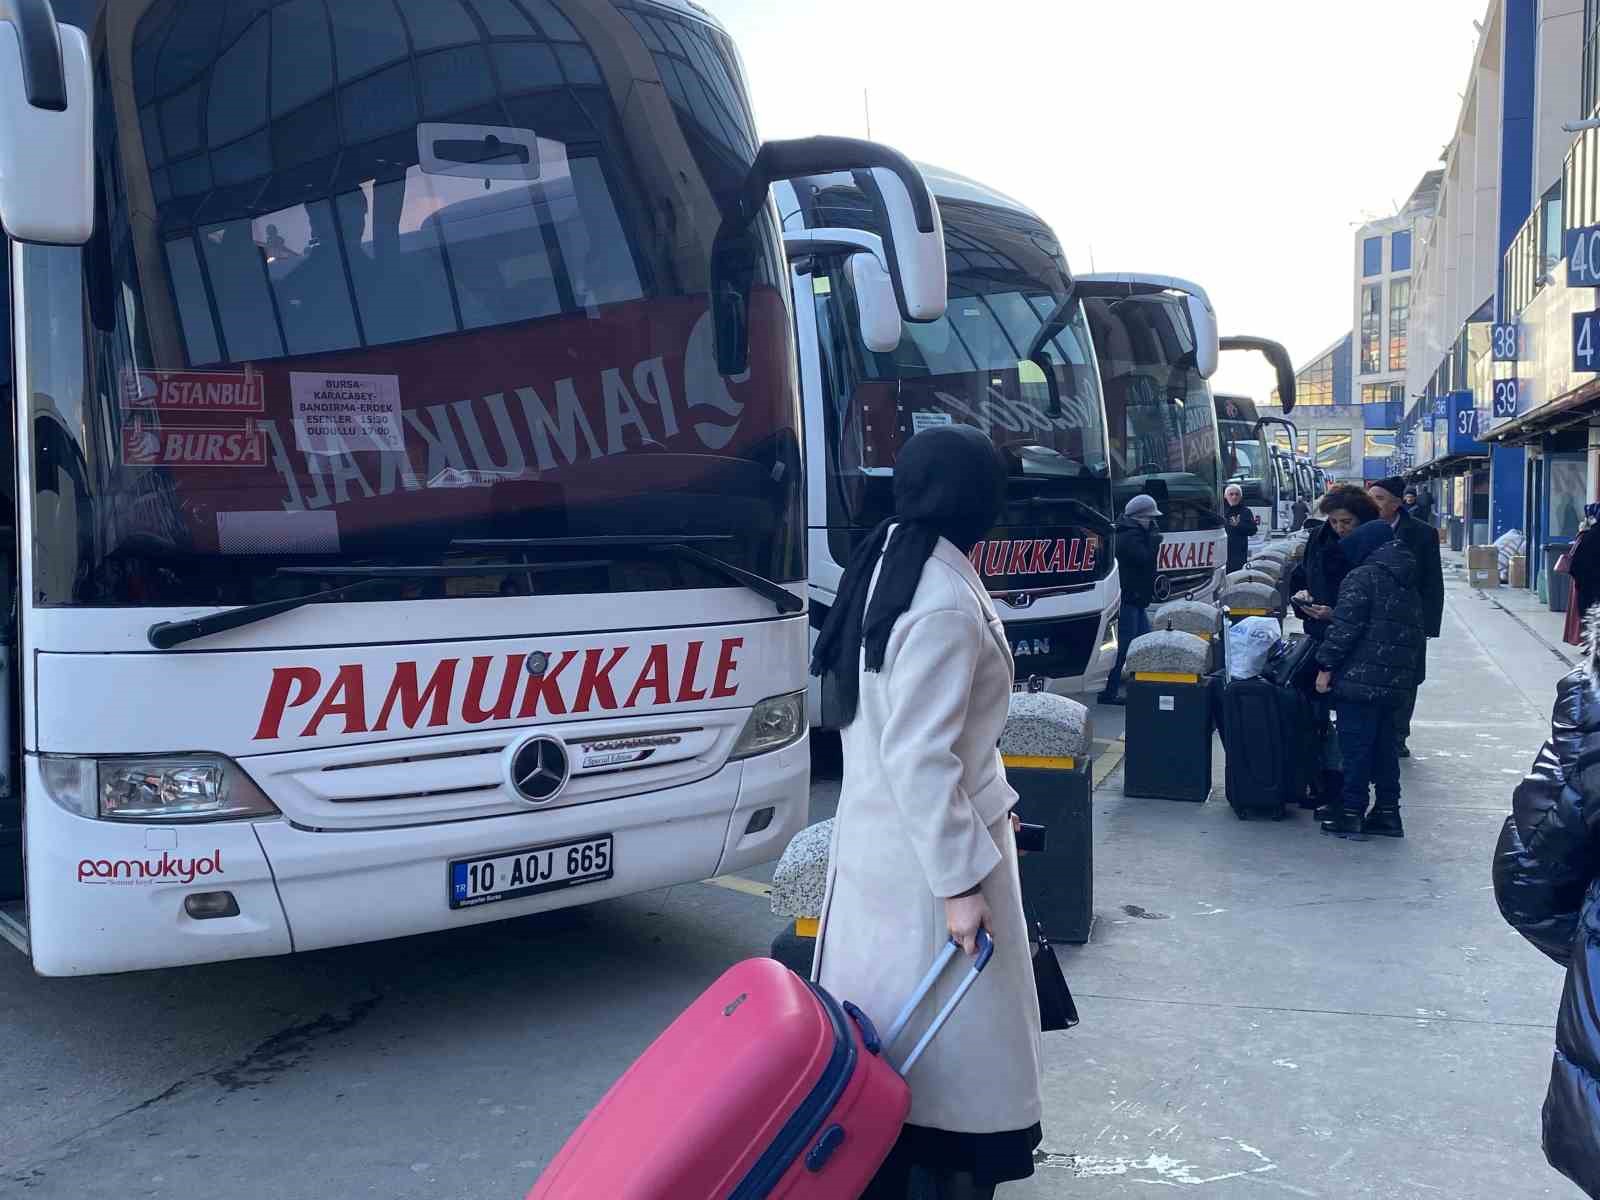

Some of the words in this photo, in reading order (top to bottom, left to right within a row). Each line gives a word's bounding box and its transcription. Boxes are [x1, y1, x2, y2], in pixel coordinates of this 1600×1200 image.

[1494, 326, 1516, 358] 38
[160, 374, 259, 405] İSTANBUL
[1495, 382, 1517, 414] 39
[1458, 410, 1475, 434] 37
[163, 433, 262, 461] BURSA
[1009, 638, 1050, 656] AN
[252, 636, 744, 740] PAMUKKALE
[77, 848, 224, 884] pamukyol
[455, 884, 467, 894] TR
[469, 862, 495, 893] 10
[510, 851, 554, 886] AOJ
[566, 841, 608, 876] 665
